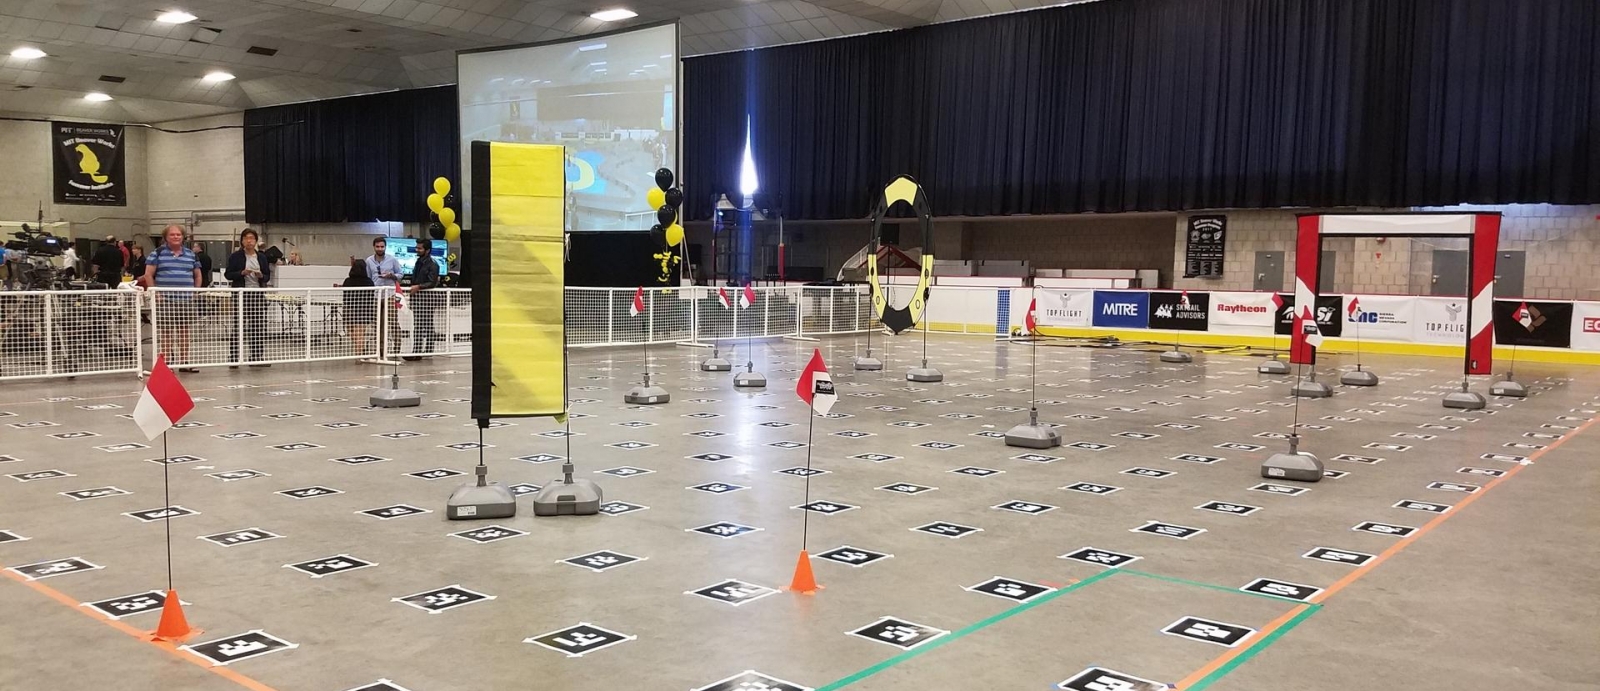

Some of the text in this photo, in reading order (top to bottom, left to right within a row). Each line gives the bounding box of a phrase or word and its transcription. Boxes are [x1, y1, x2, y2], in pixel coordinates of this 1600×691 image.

[1046, 308, 1082, 317] TOP FLIGHT
[1102, 303, 1138, 316] MITRE
[1217, 304, 1267, 313] Raytheon
[1175, 312, 1206, 320] ADVISORS
[1426, 322, 1465, 333] TOP FLIG
